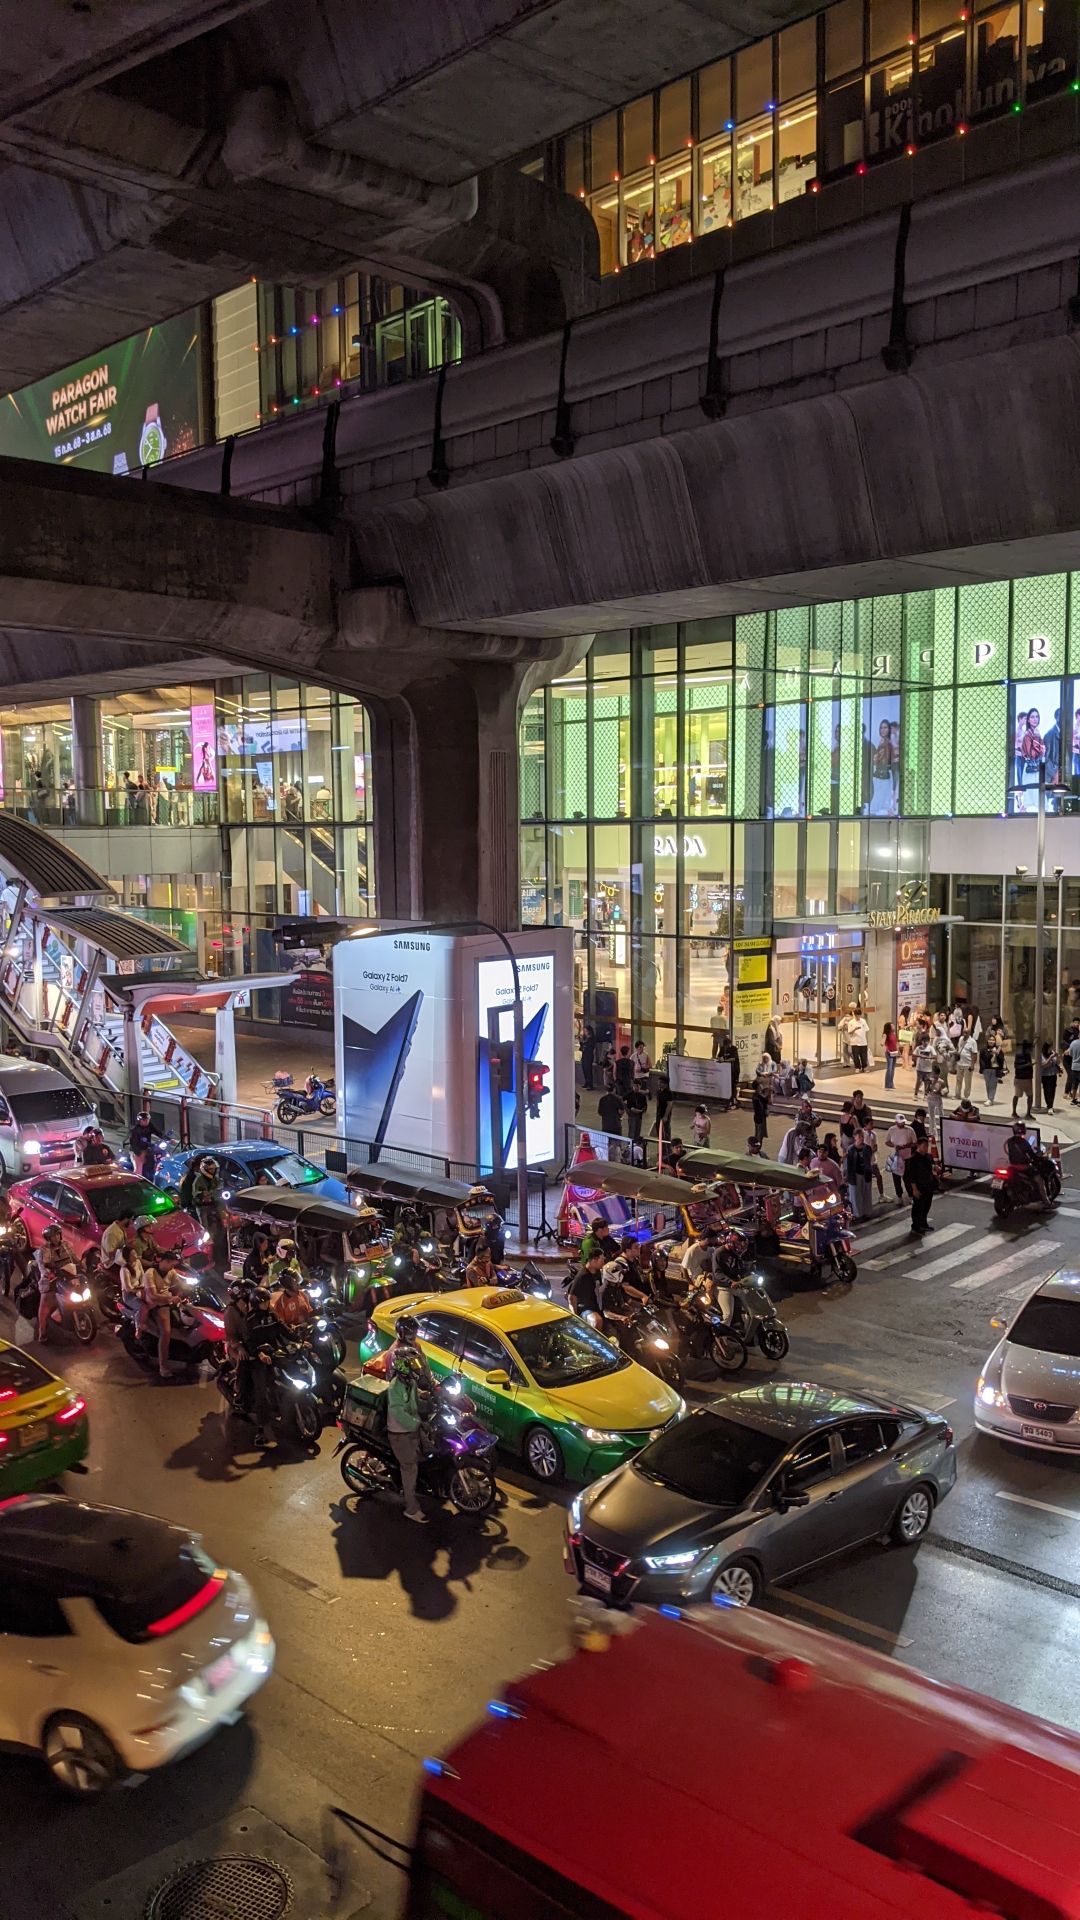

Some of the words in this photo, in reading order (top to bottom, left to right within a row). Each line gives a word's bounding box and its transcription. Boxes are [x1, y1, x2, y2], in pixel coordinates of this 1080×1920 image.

[52, 365, 109, 410] PARAGON
[46, 400, 88, 437] WATCH
[89, 385, 118, 416] FAIR
[655, 836, 706, 857] RADA
[896, 904, 941, 926] PARAGON
[393, 939, 431, 952] SAMSUNG
[517, 962, 550, 973] SAMSUNG
[362, 970, 385, 982] Galaxy
[386, 972, 391, 981] Z
[391, 973, 409, 983] Fold7
[369, 983, 389, 993] Galaxy
[495, 987, 516, 996] Galax
[522, 984, 539, 993] Fold7
[949, 1136, 984, 1148] ทางออก
[956, 1149, 978, 1160] EXIT
